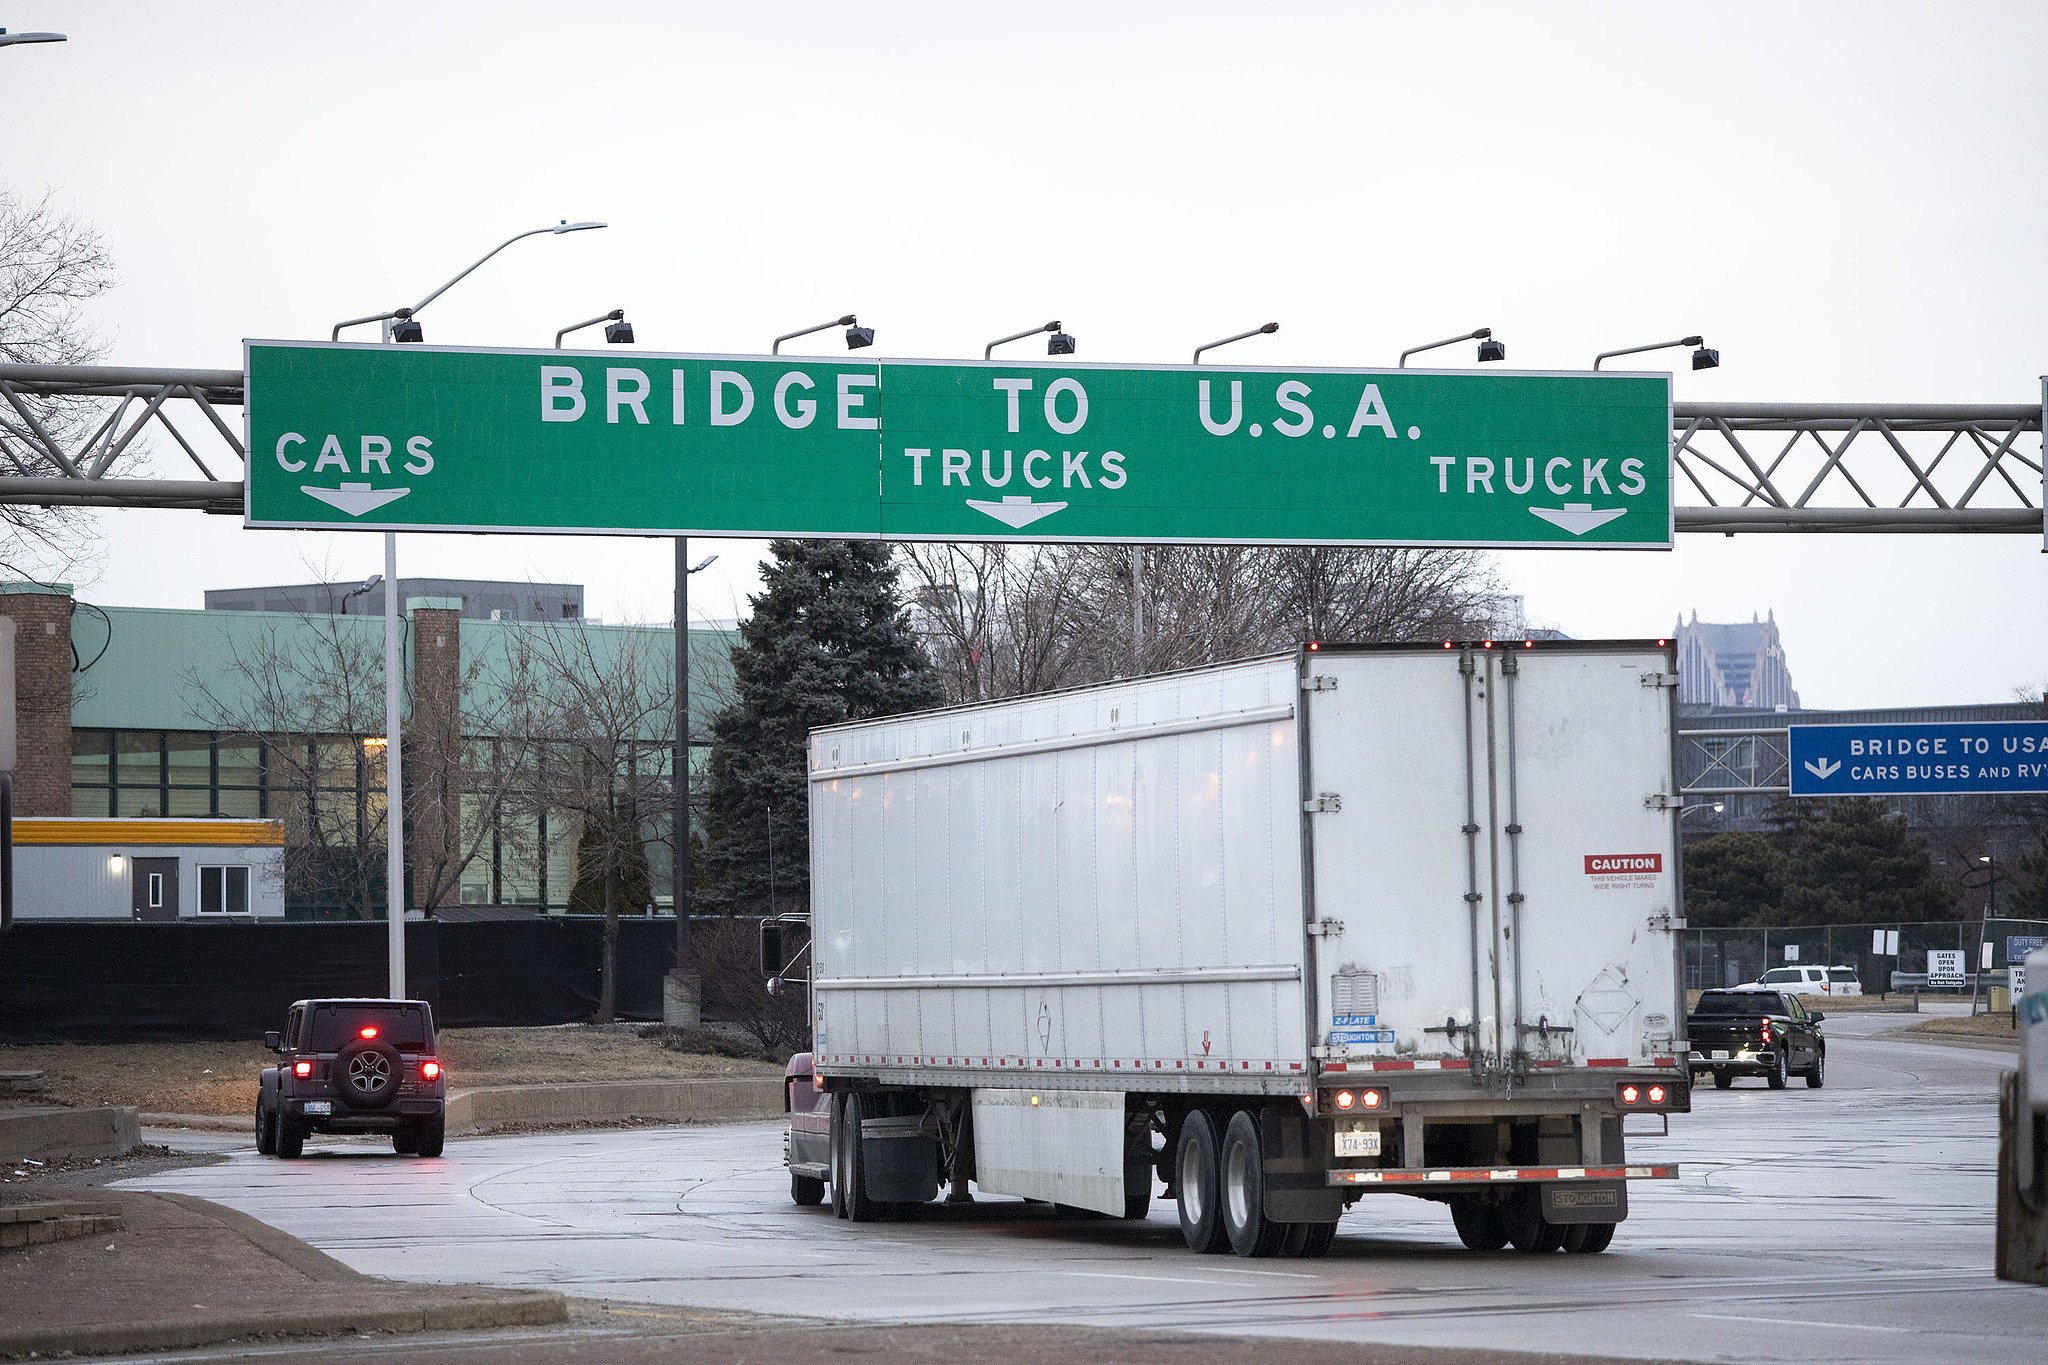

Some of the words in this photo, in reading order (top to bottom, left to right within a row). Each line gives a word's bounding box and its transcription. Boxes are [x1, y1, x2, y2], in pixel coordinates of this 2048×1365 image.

[540, 365, 878, 430] BRIDGE
[993, 377, 1089, 435] TO
[1198, 379, 1421, 440] U.S.A.
[275, 432, 435, 477] CARS
[904, 448, 1128, 490] TRUCKS
[1429, 456, 1646, 496] TRUCKS
[1850, 738, 1947, 756] BRIDGE
[1959, 737, 1989, 754] TO
[2003, 736, 2048, 753] USA
[1850, 766, 1899, 780] CARS
[1906, 765, 1970, 779] BUSES
[1978, 767, 2010, 778] AND
[2018, 763, 2048, 778] RV'
[1591, 858, 1655, 870] CAUTION
[2013, 938, 2028, 946] DUTY
[2029, 938, 2043, 947] FREE
[1334, 1016, 1370, 1025] Z-PLATE
[1332, 1032, 1375, 1042] STOUGHTON
[1554, 1192, 1615, 1206] STOUGHTON
